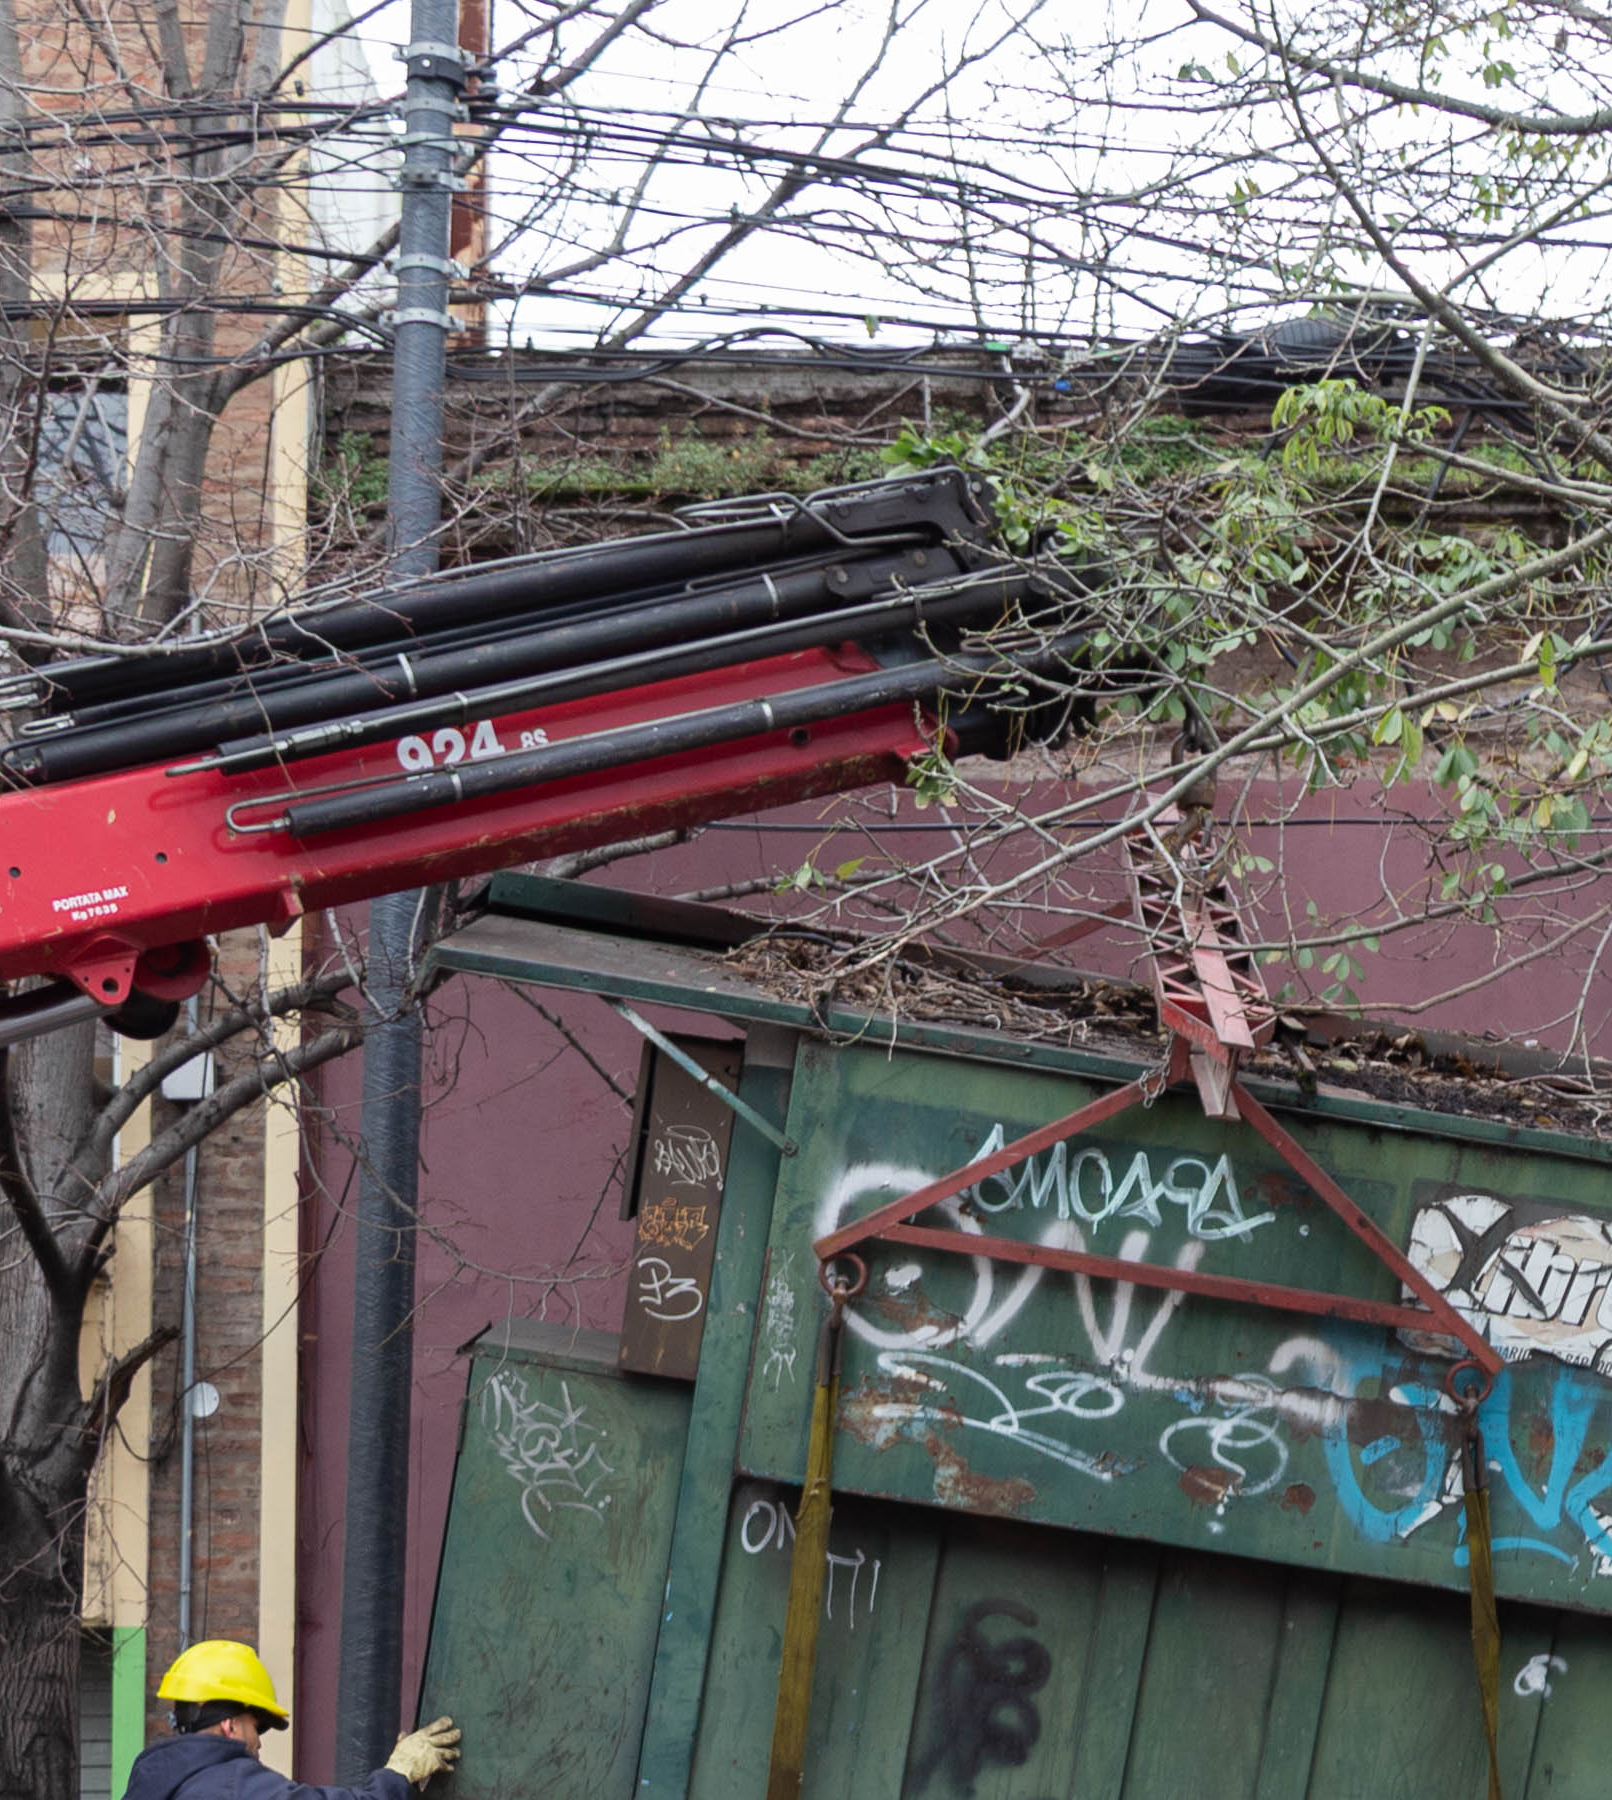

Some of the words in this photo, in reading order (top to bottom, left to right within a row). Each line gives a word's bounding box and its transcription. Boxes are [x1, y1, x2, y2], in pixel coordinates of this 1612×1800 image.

[396, 719, 507, 782] 924
[52, 892, 104, 913] PORTATA
[102, 885, 129, 901] MAX
